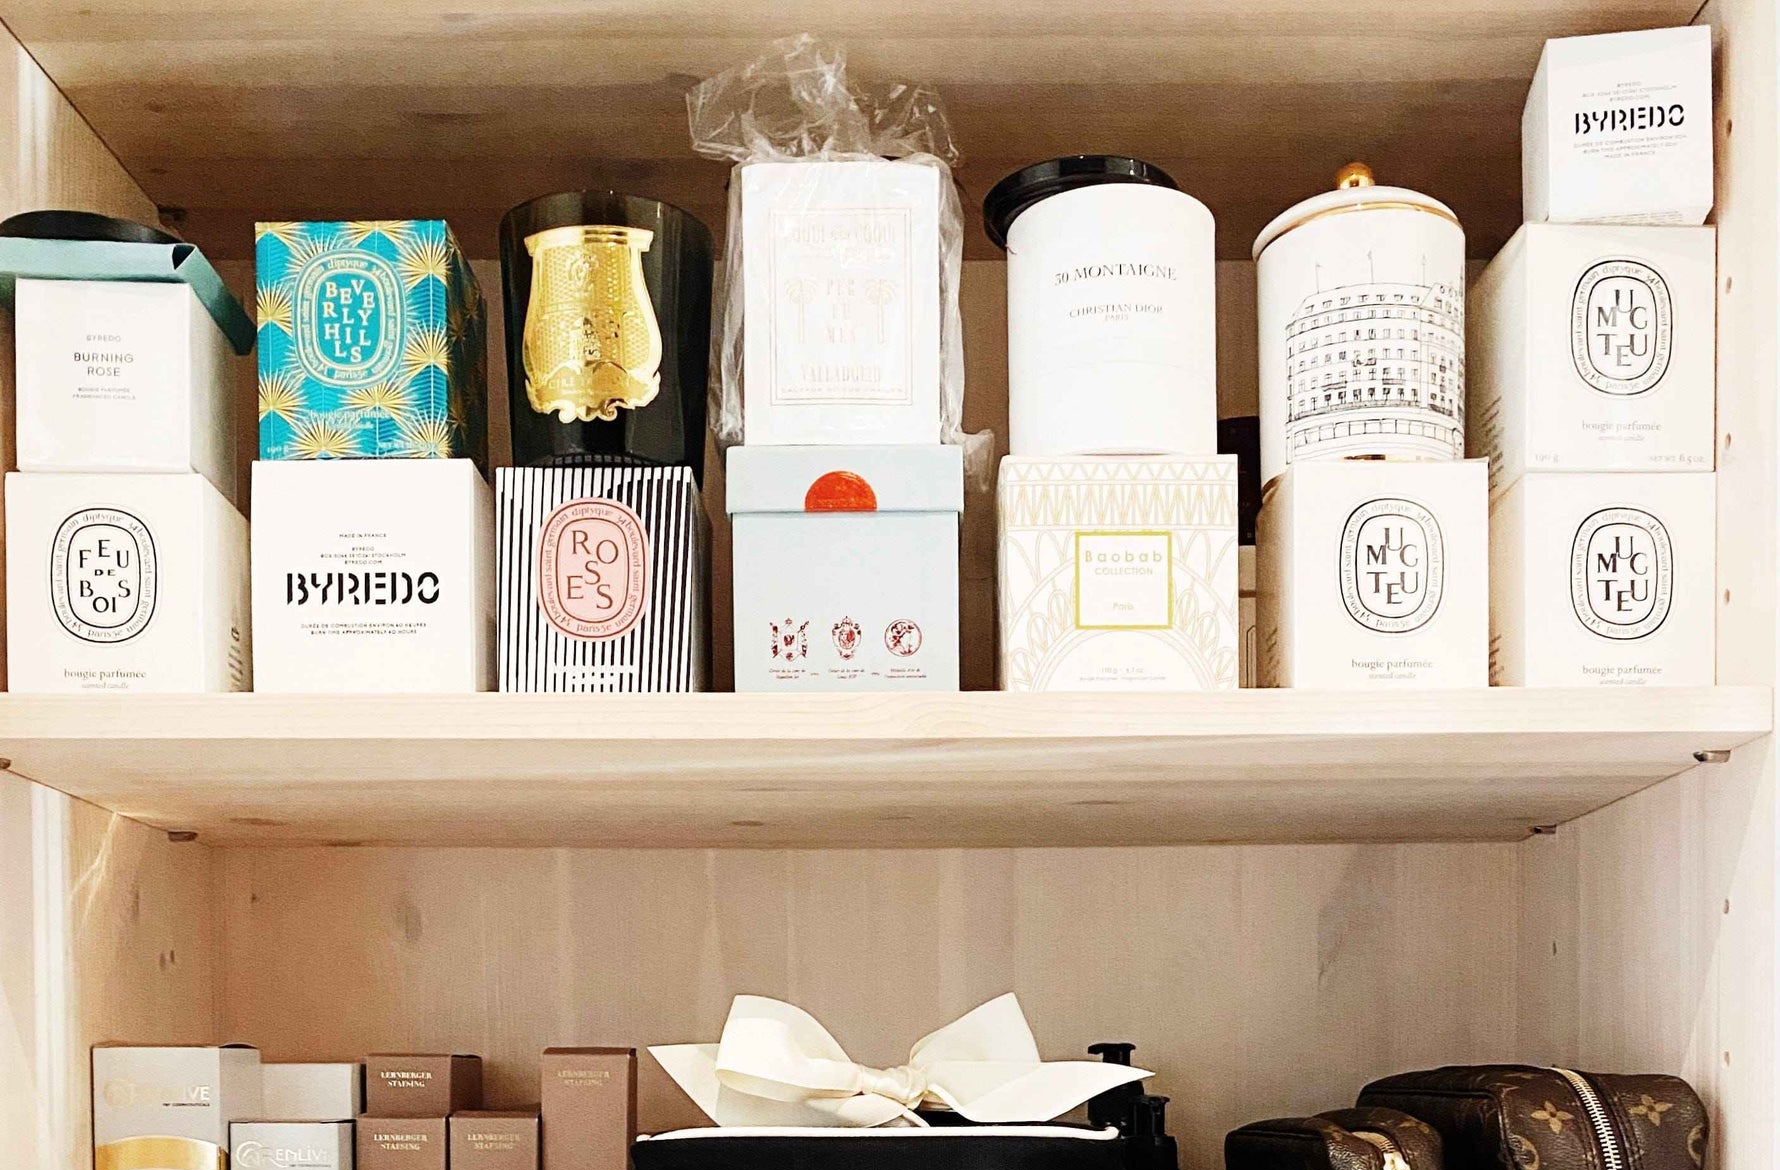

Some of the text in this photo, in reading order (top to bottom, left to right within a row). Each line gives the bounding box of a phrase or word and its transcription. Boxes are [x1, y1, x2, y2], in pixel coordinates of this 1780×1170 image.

[1575, 104, 1684, 134] BYREDO
[1074, 264, 1177, 281] MONTAIGNE
[1070, 304, 1162, 318] CHRISTIAN DIOR
[73, 352, 134, 363] BURNING
[87, 367, 120, 376] ROSE
[572, 507, 614, 517] diptyque
[1085, 550, 1162, 562] Baobab
[287, 572, 440, 605] BYREDO
[1352, 659, 1384, 670] bougie
[64, 669, 96, 680] bougie
[1583, 665, 1614, 676] bougie
